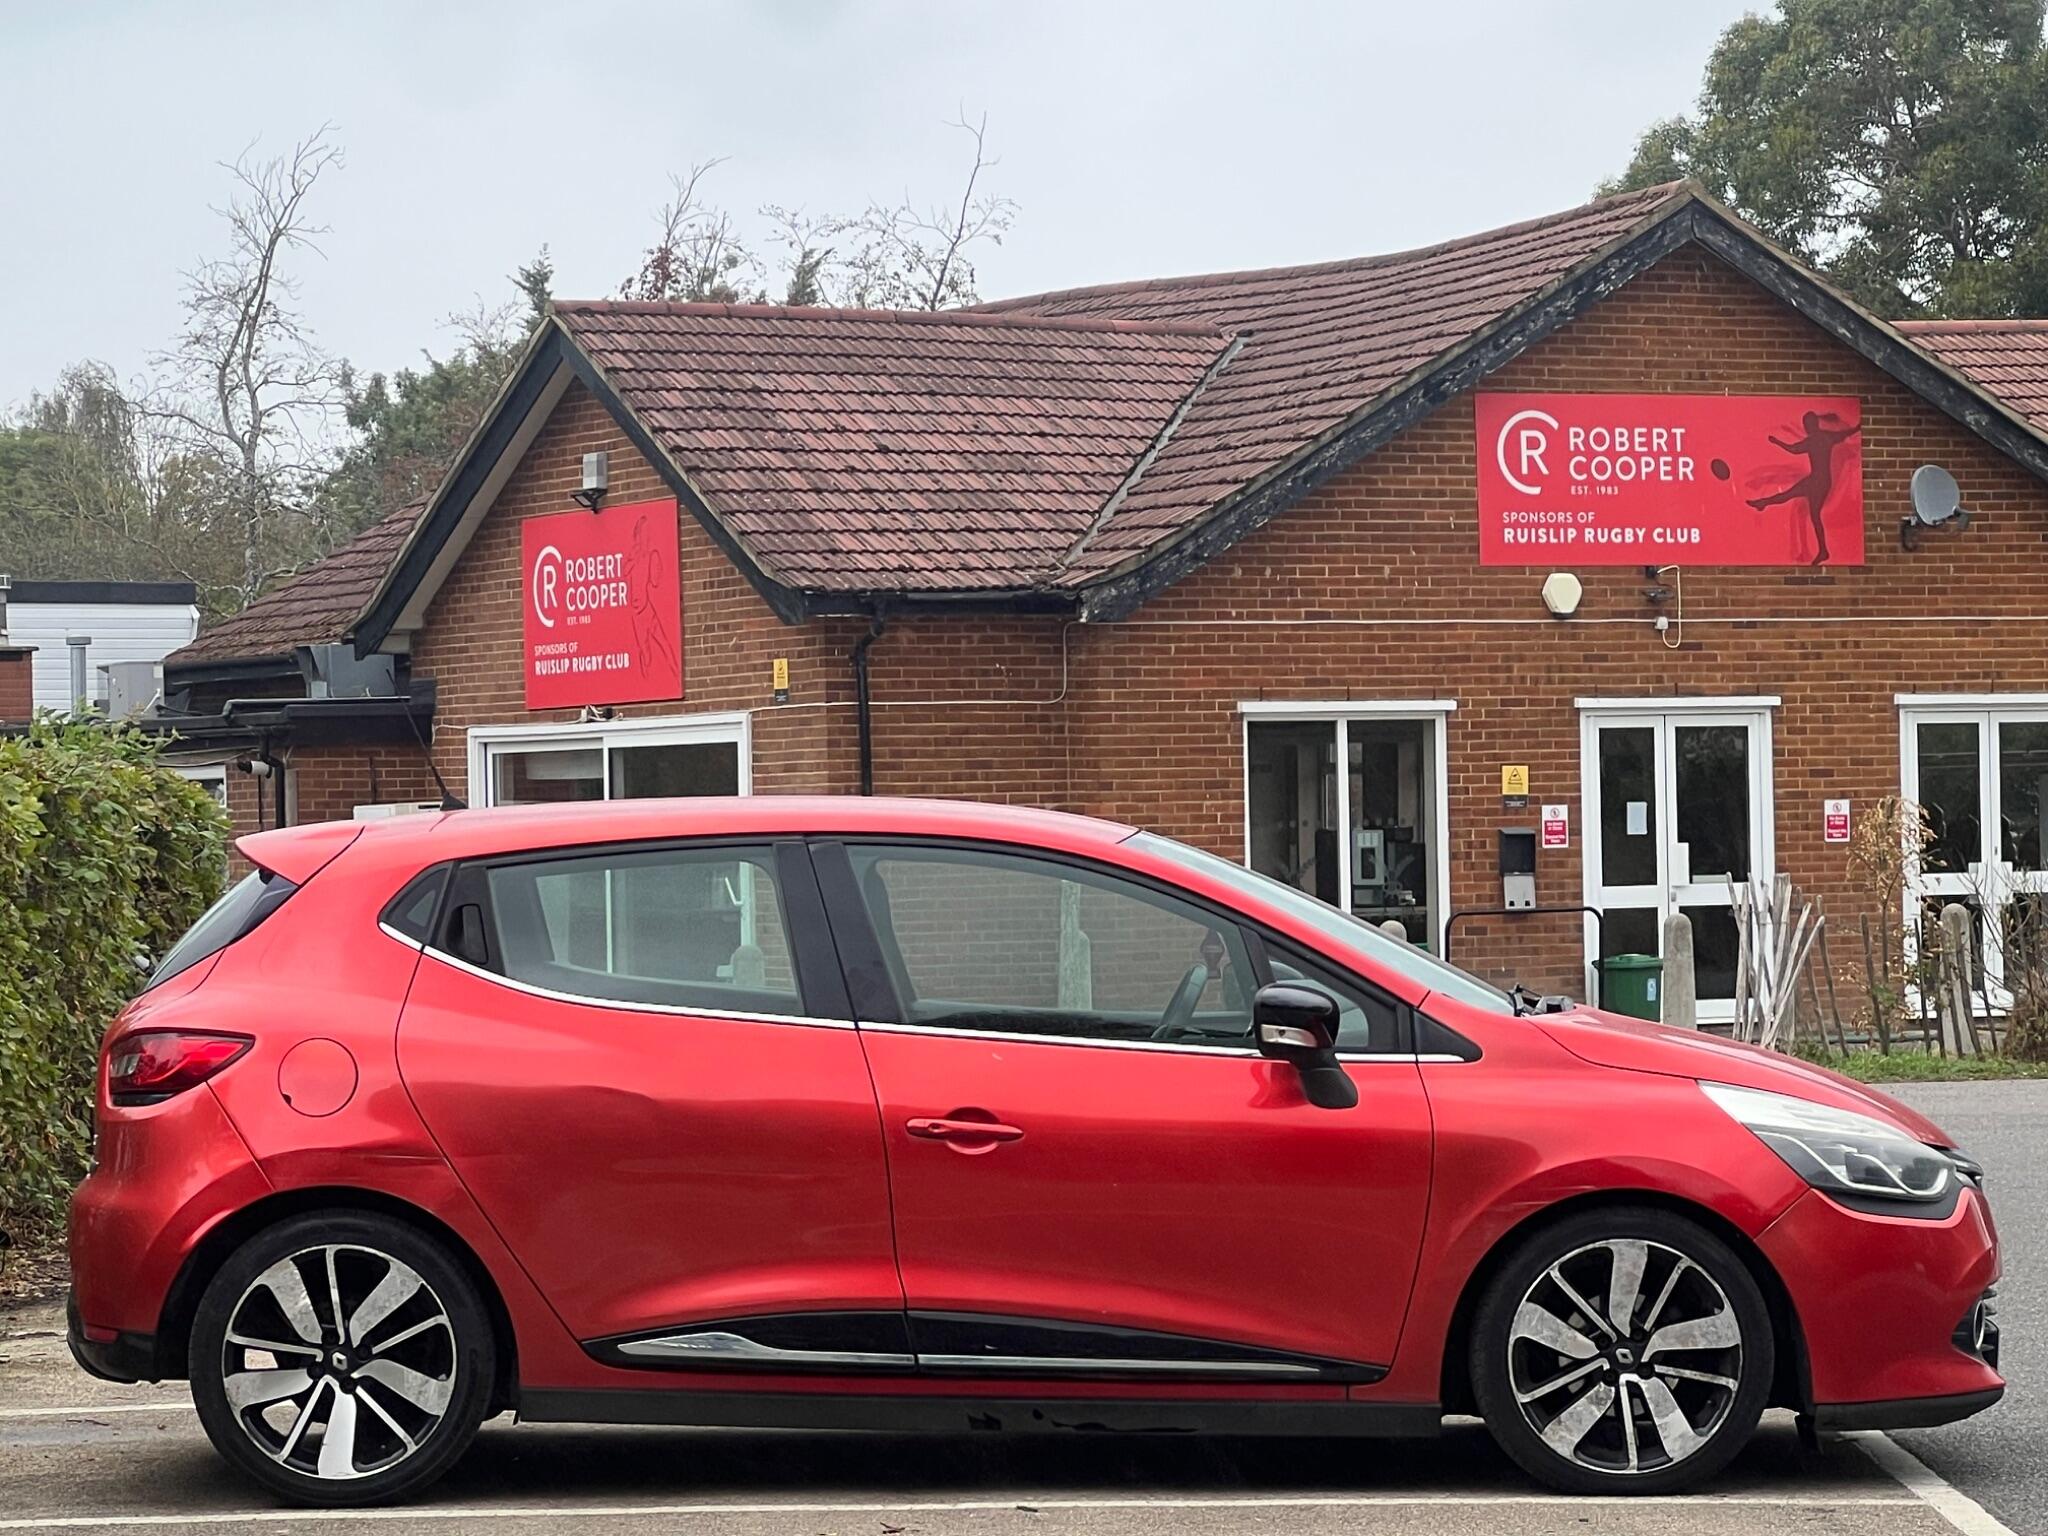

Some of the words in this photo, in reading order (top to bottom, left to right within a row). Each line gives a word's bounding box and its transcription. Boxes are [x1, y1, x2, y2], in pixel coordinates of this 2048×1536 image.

[1569, 427, 1685, 452] ROBERT
[1569, 456, 1695, 481] COOPER
[1571, 486, 1592, 495] EST.
[1596, 486, 1619, 495] 1983
[1503, 512, 1573, 523] SPONSORS
[1577, 512, 1595, 523] OF
[1504, 528, 1577, 543] RUISLIP
[1584, 528, 1646, 543] RUGBY
[1652, 528, 1701, 543] CLUB
[566, 553, 623, 583] ROBERT
[566, 582, 627, 611] COOPER
[535, 643, 568, 656] SPONSORS
[569, 642, 578, 653] OF
[535, 658, 570, 675] RUISLIP
[572, 655, 603, 672] RUGBY
[605, 652, 630, 669] CLUB
